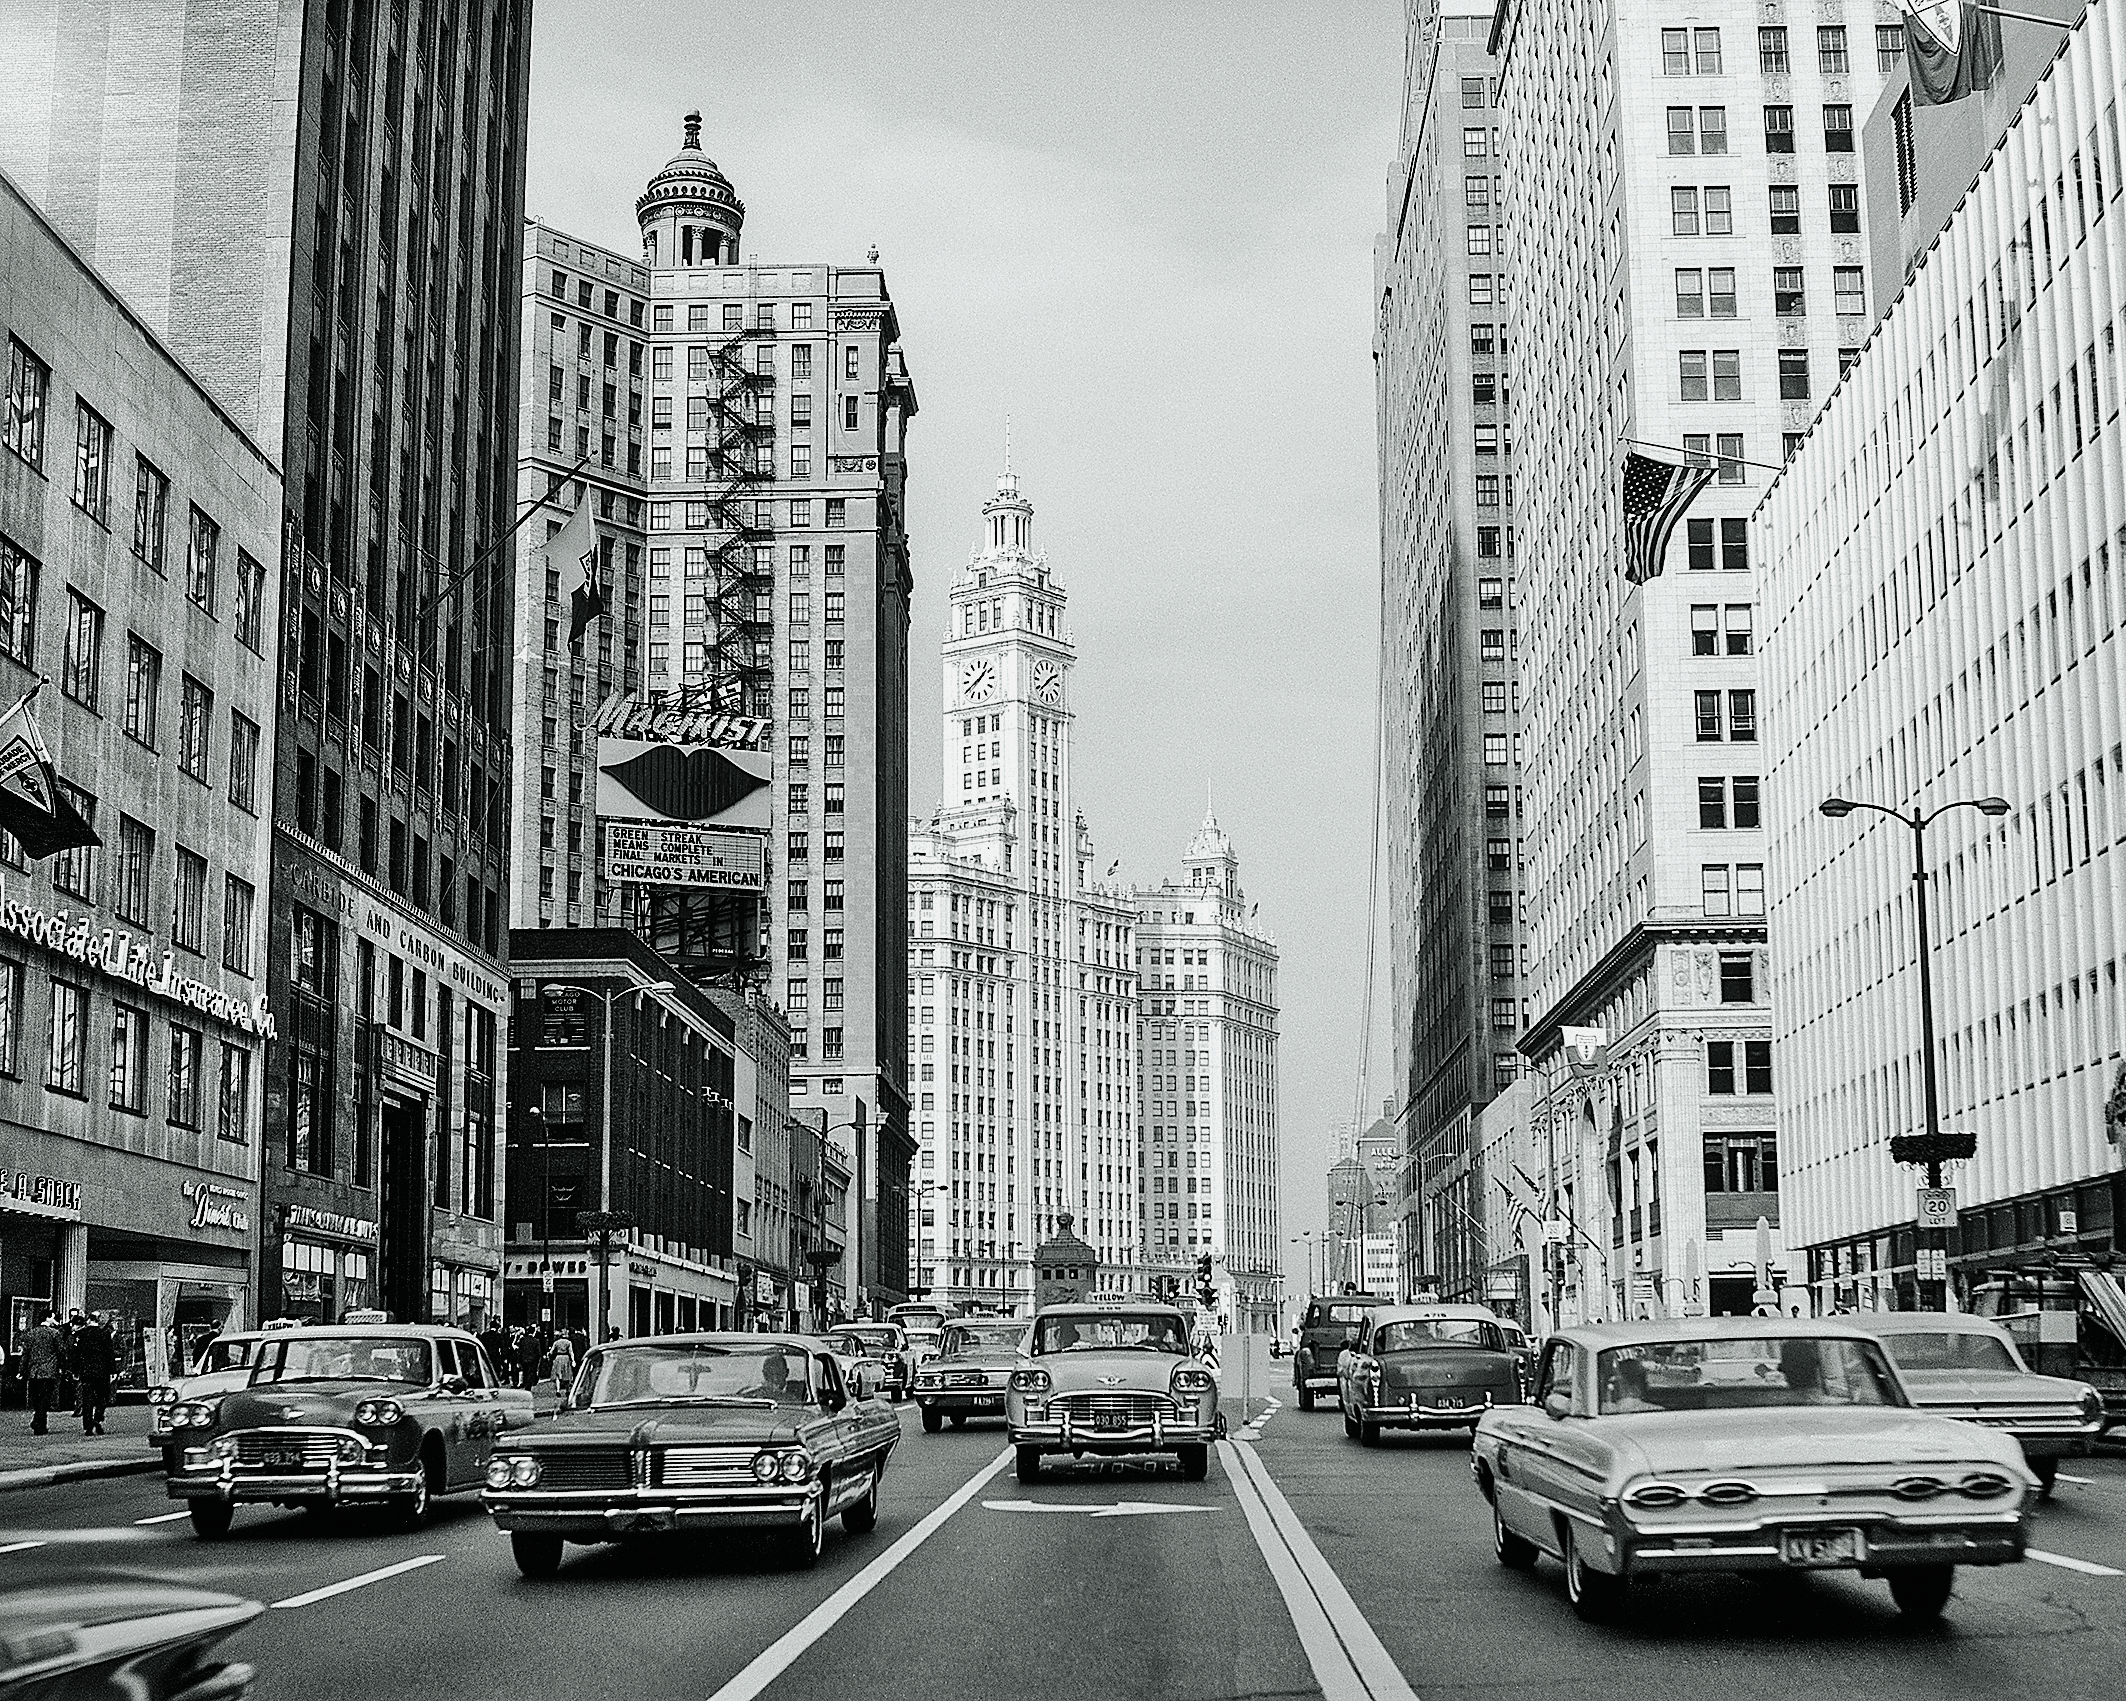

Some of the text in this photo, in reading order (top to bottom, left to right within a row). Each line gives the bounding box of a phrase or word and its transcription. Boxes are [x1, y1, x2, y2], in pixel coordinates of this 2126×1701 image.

[3, 752, 31, 771] MERCY
[613, 828, 703, 844] GREEN STREAK
[613, 839, 713, 856] MEANS COMPLETE
[613, 850, 723, 866] FINAL MARKETS IN
[612, 863, 759, 887] CHICAGO'S AMERICAN
[291, 862, 499, 1004] CARBIDE AND CARBON BUILDING
[18, 1173, 28, 1201] A
[36, 1177, 82, 1211] SNACK
[1928, 1200, 1946, 1212] 20
[1093, 1293, 1125, 1301] YELLOW
